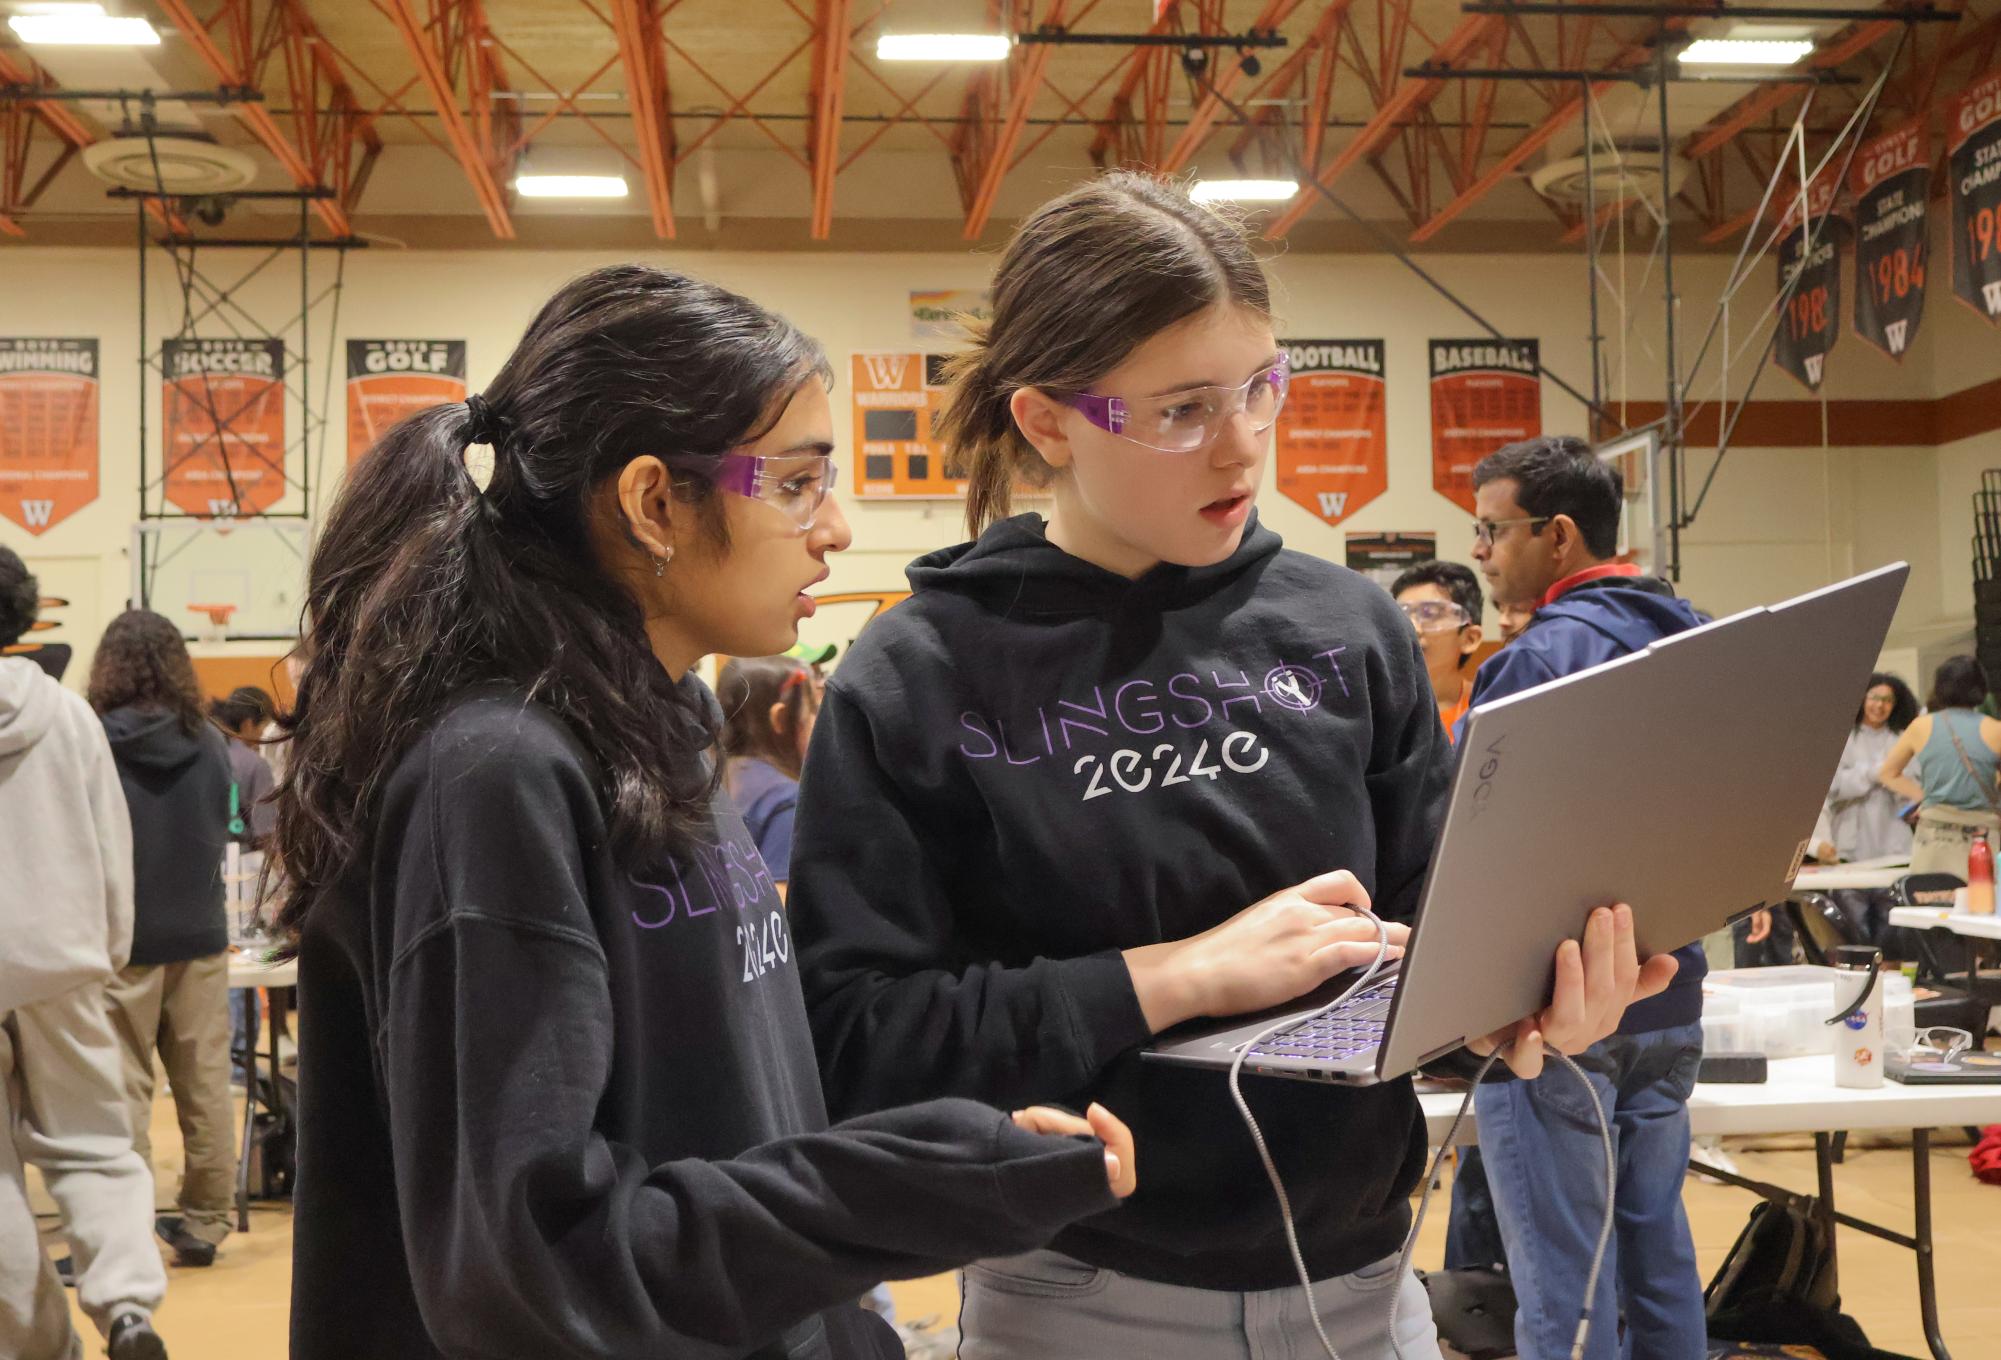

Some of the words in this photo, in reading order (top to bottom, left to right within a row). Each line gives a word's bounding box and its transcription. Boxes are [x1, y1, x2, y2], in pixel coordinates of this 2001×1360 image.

[1869, 242, 1924, 304] 1984
[1885, 318, 1908, 355] W
[365, 350, 448, 373] GOLF
[1288, 345, 1380, 371] OOTBALL
[1434, 345, 1534, 373] BASEBALL
[1804, 352, 1824, 385] W
[20, 499, 54, 527] W
[1317, 491, 1348, 517] W
